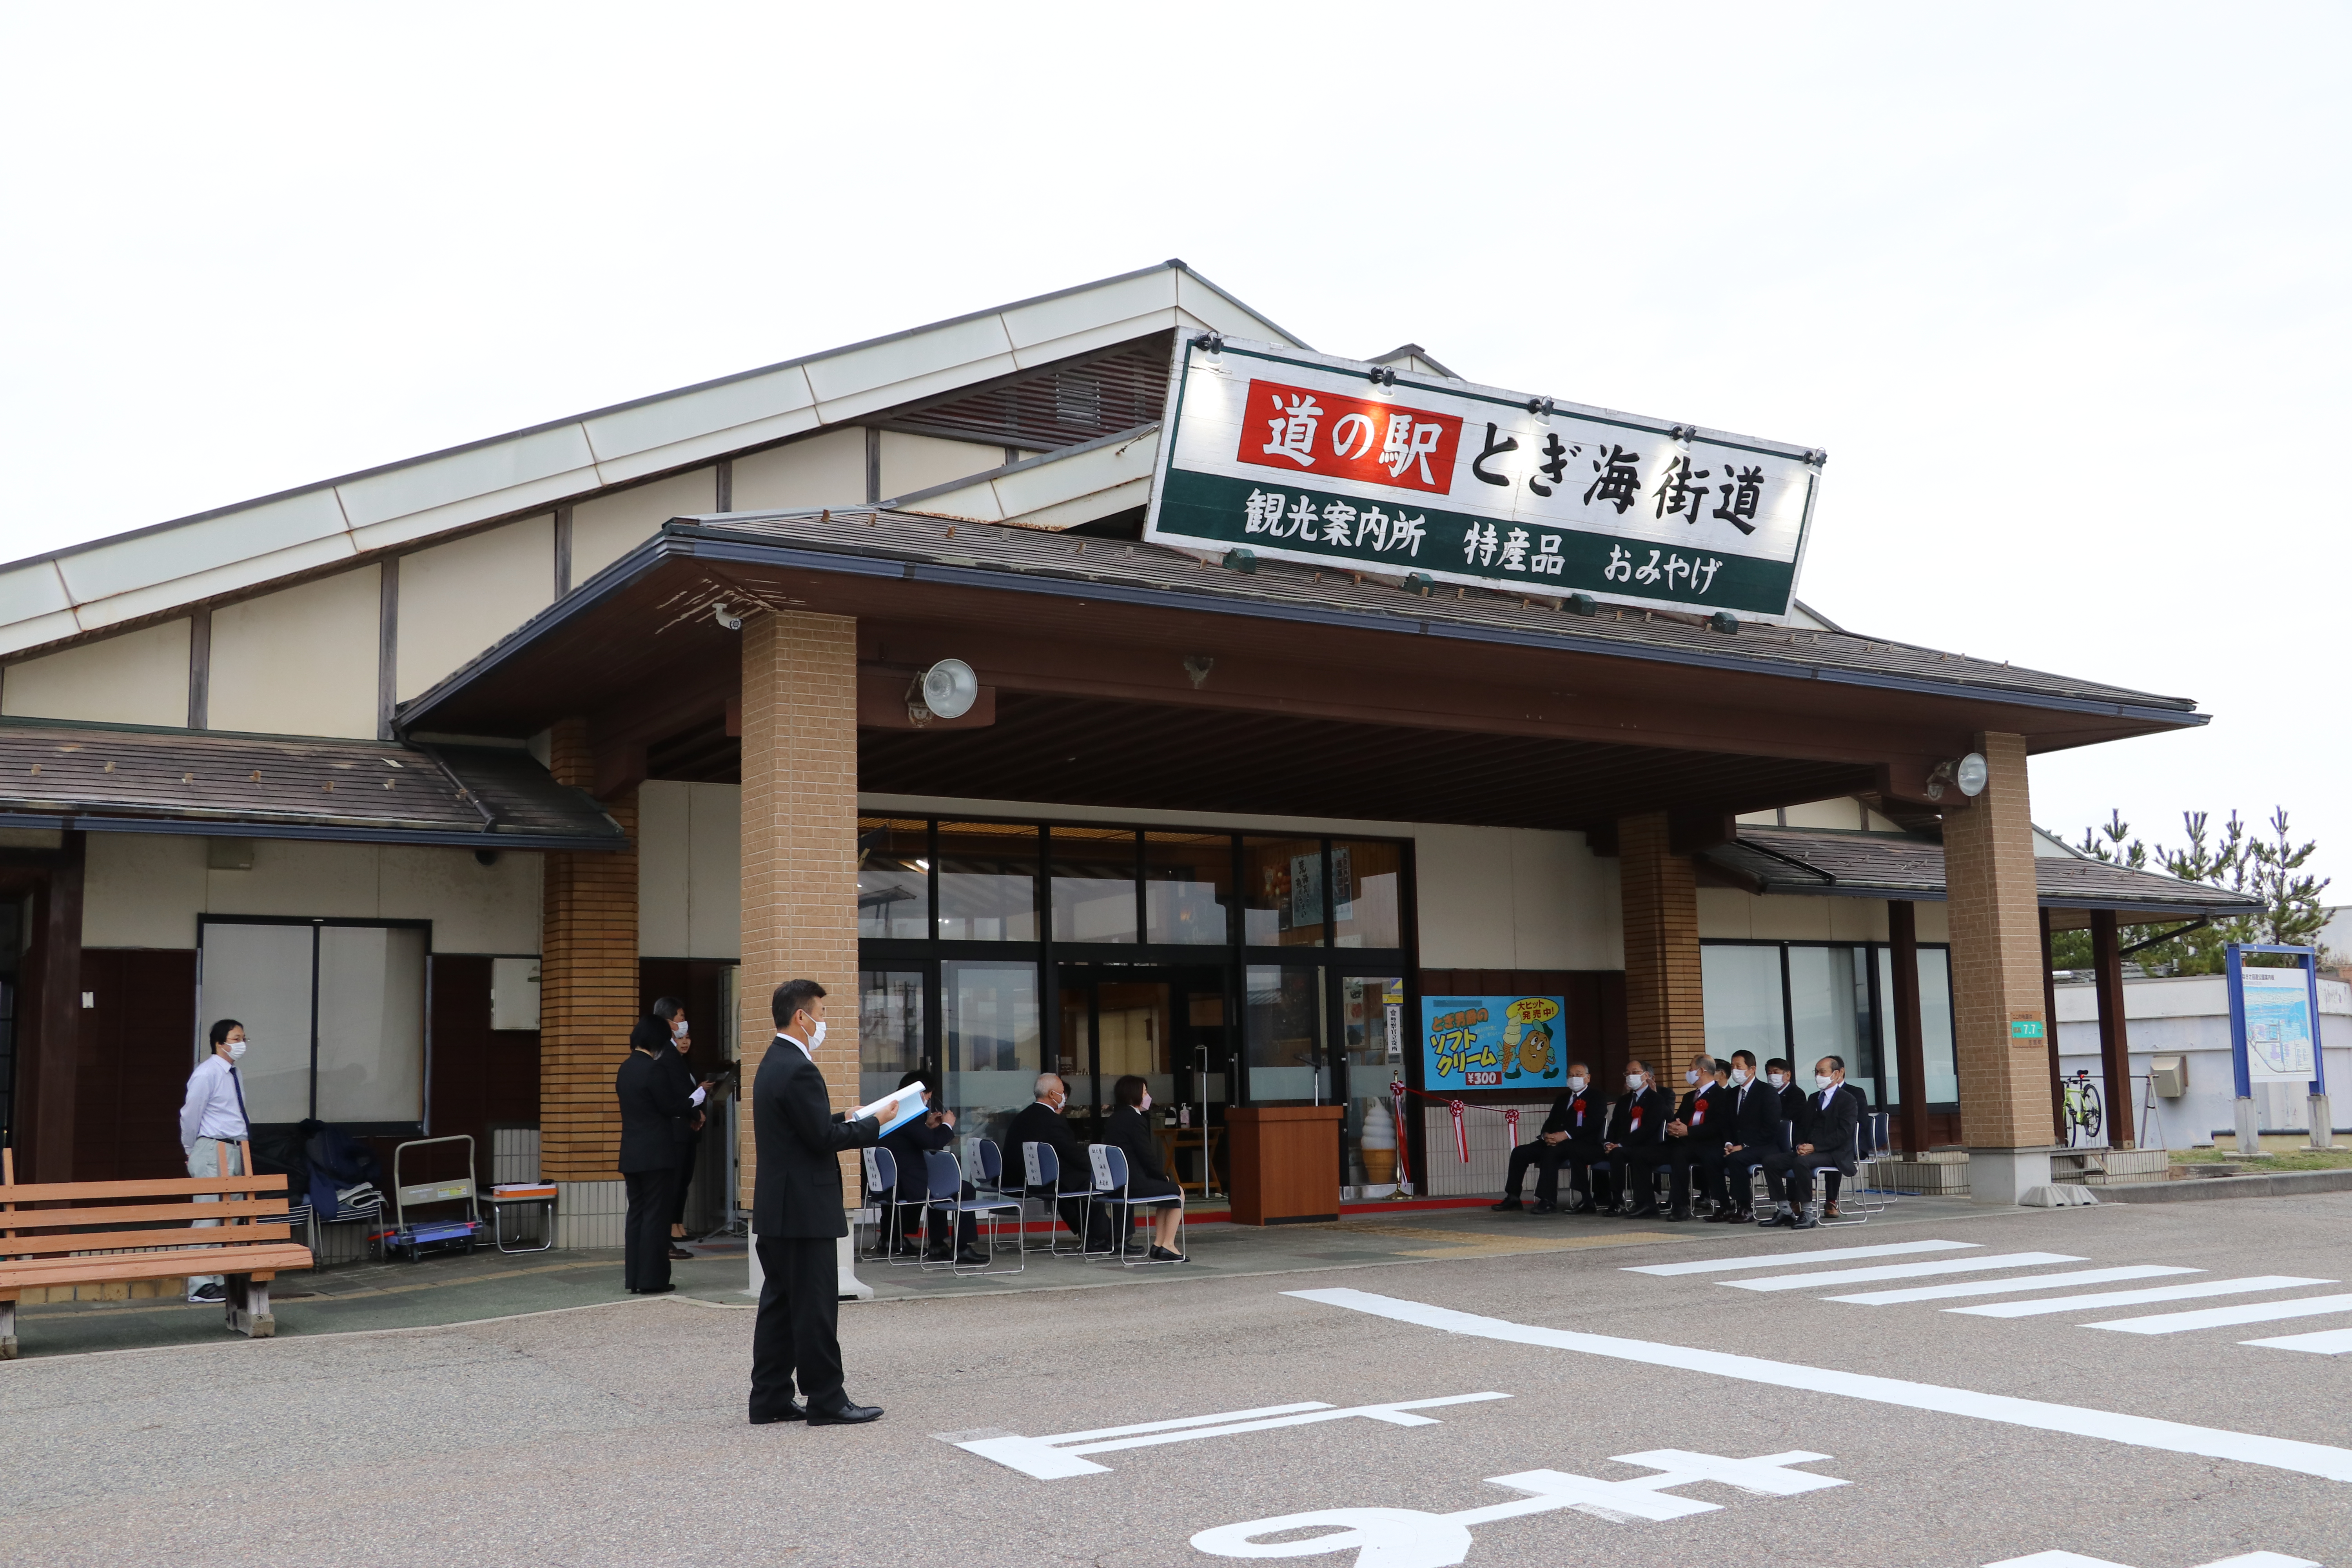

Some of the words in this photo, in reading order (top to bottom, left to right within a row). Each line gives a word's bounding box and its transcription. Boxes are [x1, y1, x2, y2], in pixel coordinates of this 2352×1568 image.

[1263, 393, 1443, 485] 道の駅
[1472, 422, 1764, 535] とぎ海街道
[1243, 488, 1426, 557] 観光案内所
[1463, 521, 1566, 575] 特産品
[1604, 544, 1724, 595] おみやげ
[1517, 1000, 1544, 1011] 大ヒット
[1430, 1027, 1477, 1055] ソフト
[2023, 1024, 2035, 1034] 7.7
[1436, 1045, 1498, 1078] クリーム
[1467, 1072, 1497, 1085] ¥300
